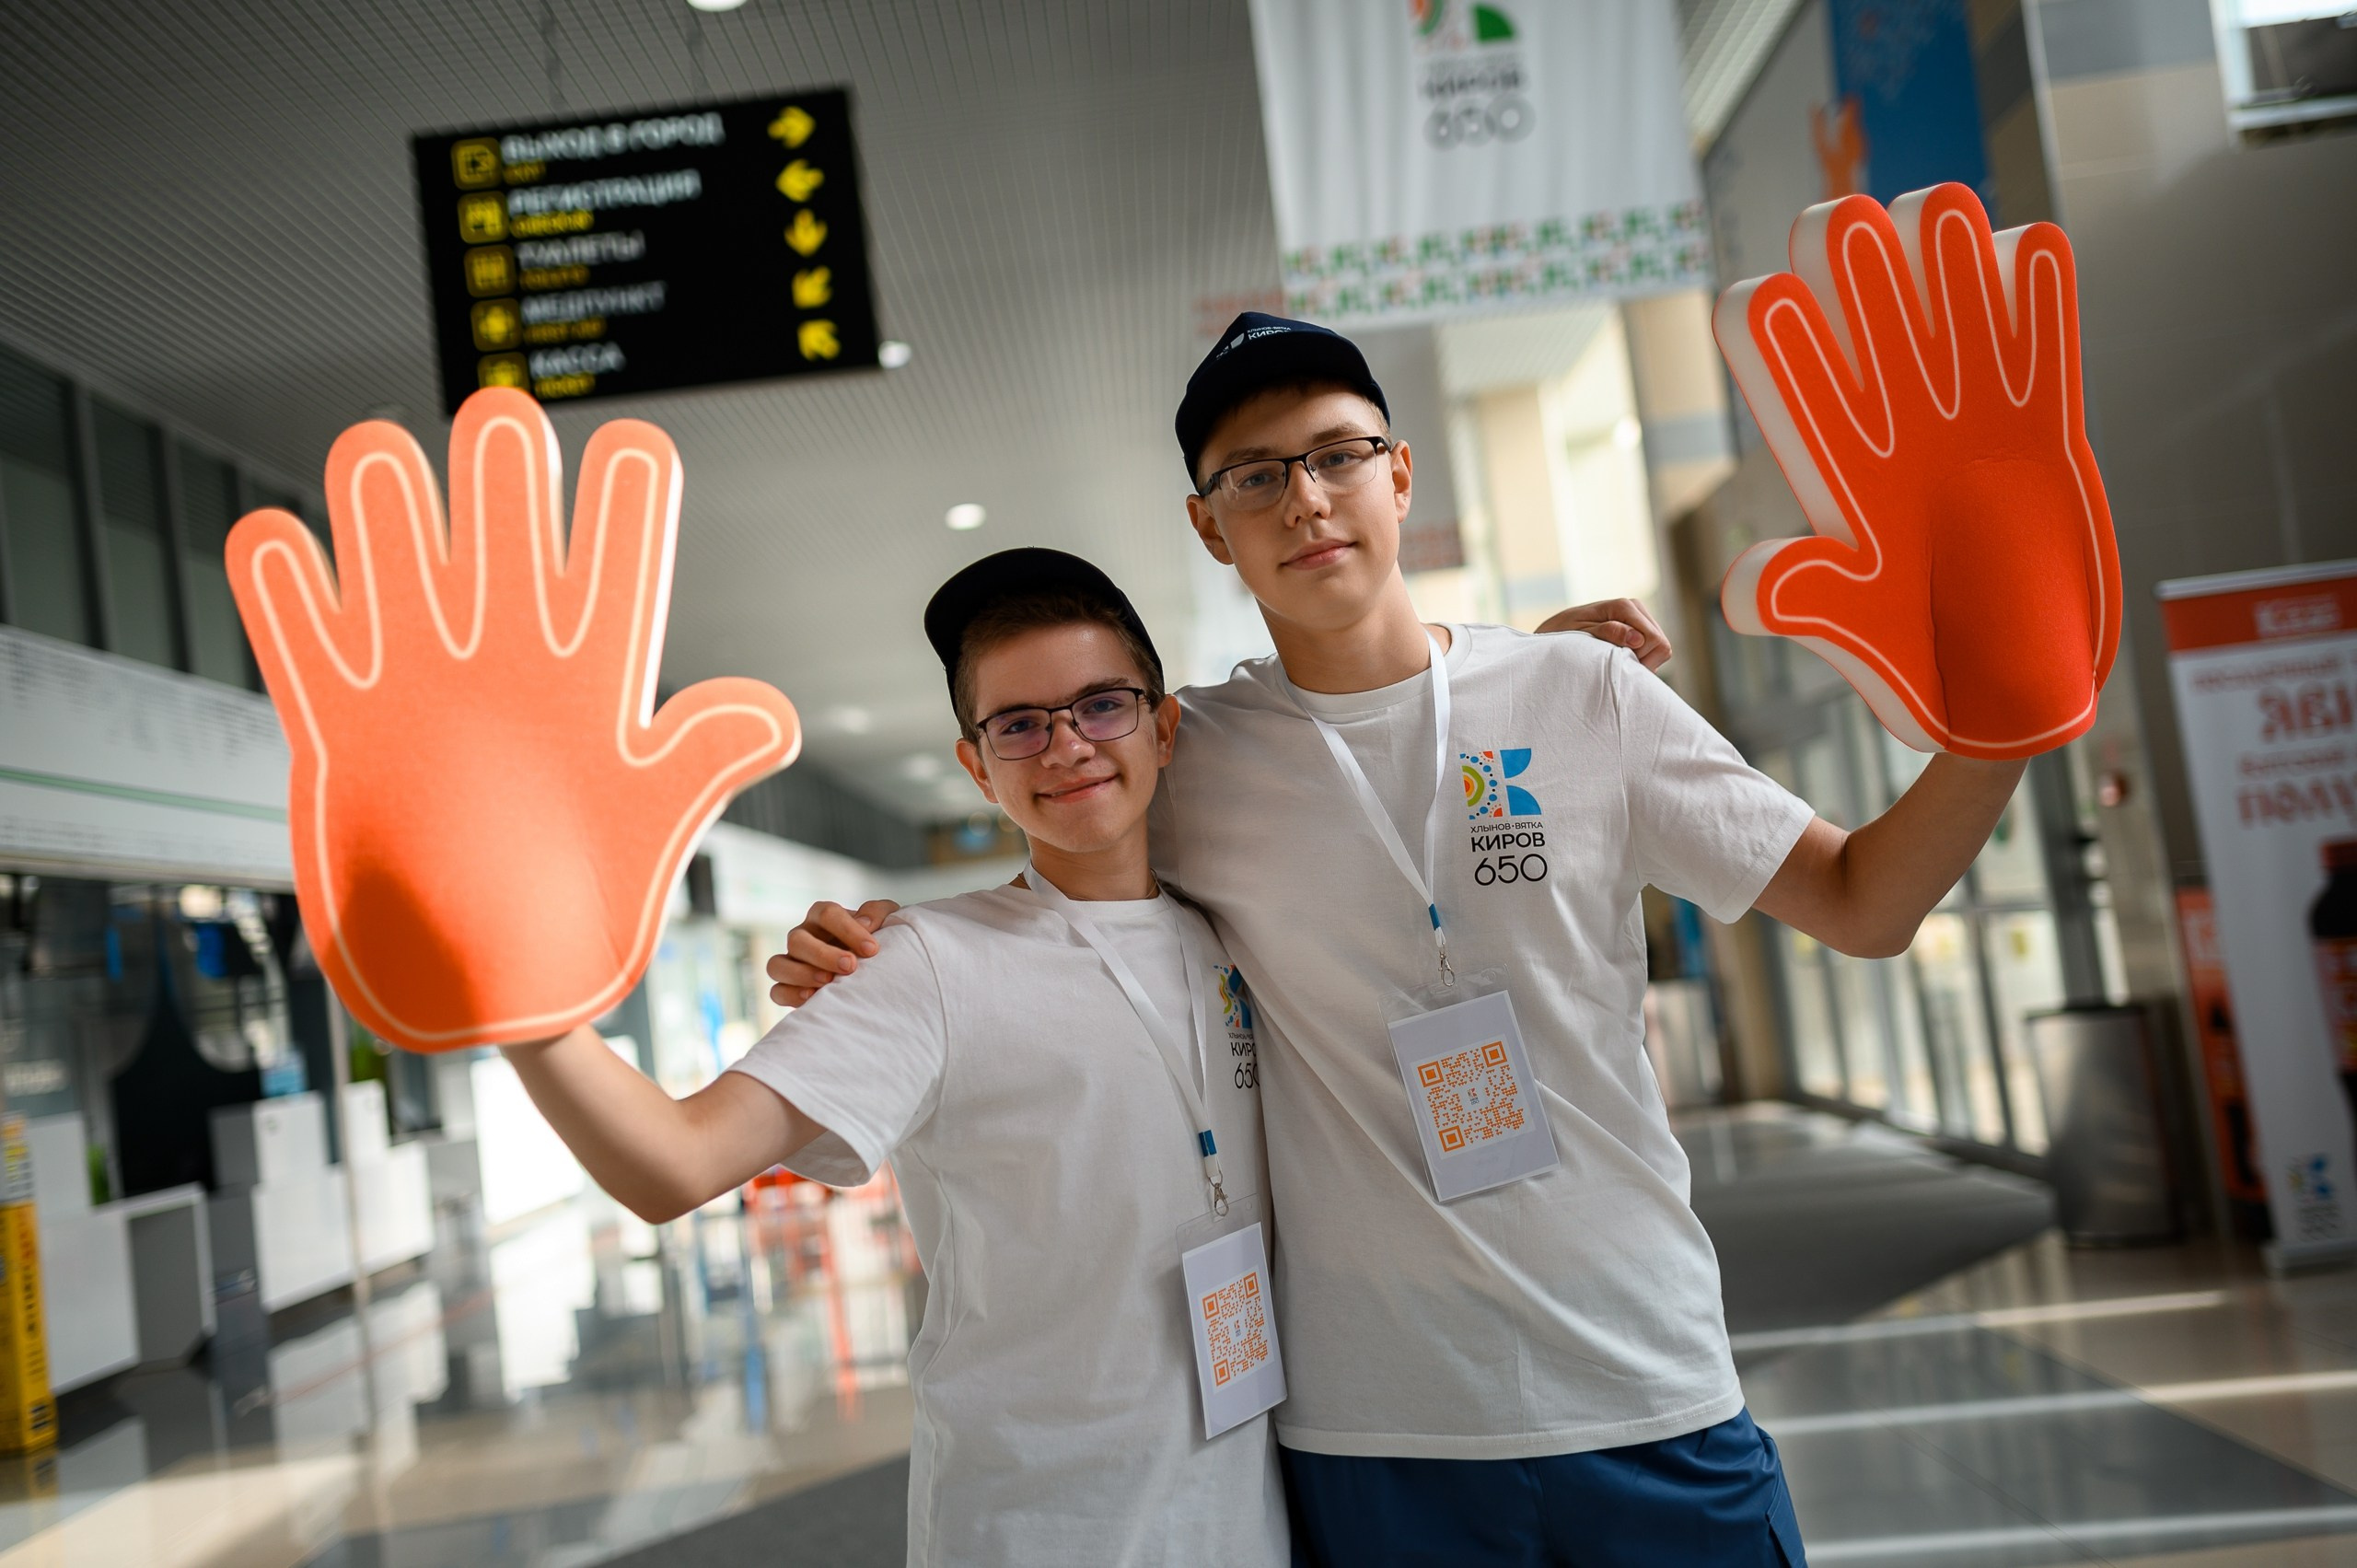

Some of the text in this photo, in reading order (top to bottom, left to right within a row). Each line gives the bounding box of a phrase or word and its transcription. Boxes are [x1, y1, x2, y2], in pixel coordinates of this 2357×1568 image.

[503, 128, 604, 162] ВЫХОД
[630, 114, 723, 149] ГОРОД
[510, 172, 700, 215] РЕГИСТРАЦИЯ
[517, 232, 644, 267] ТУАЛЕТЫ
[523, 283, 666, 323] МЕДПУНКТ
[531, 343, 624, 377] КАССА
[1471, 832, 1546, 852] КИРОВ
[1474, 854, 1548, 886] 650
